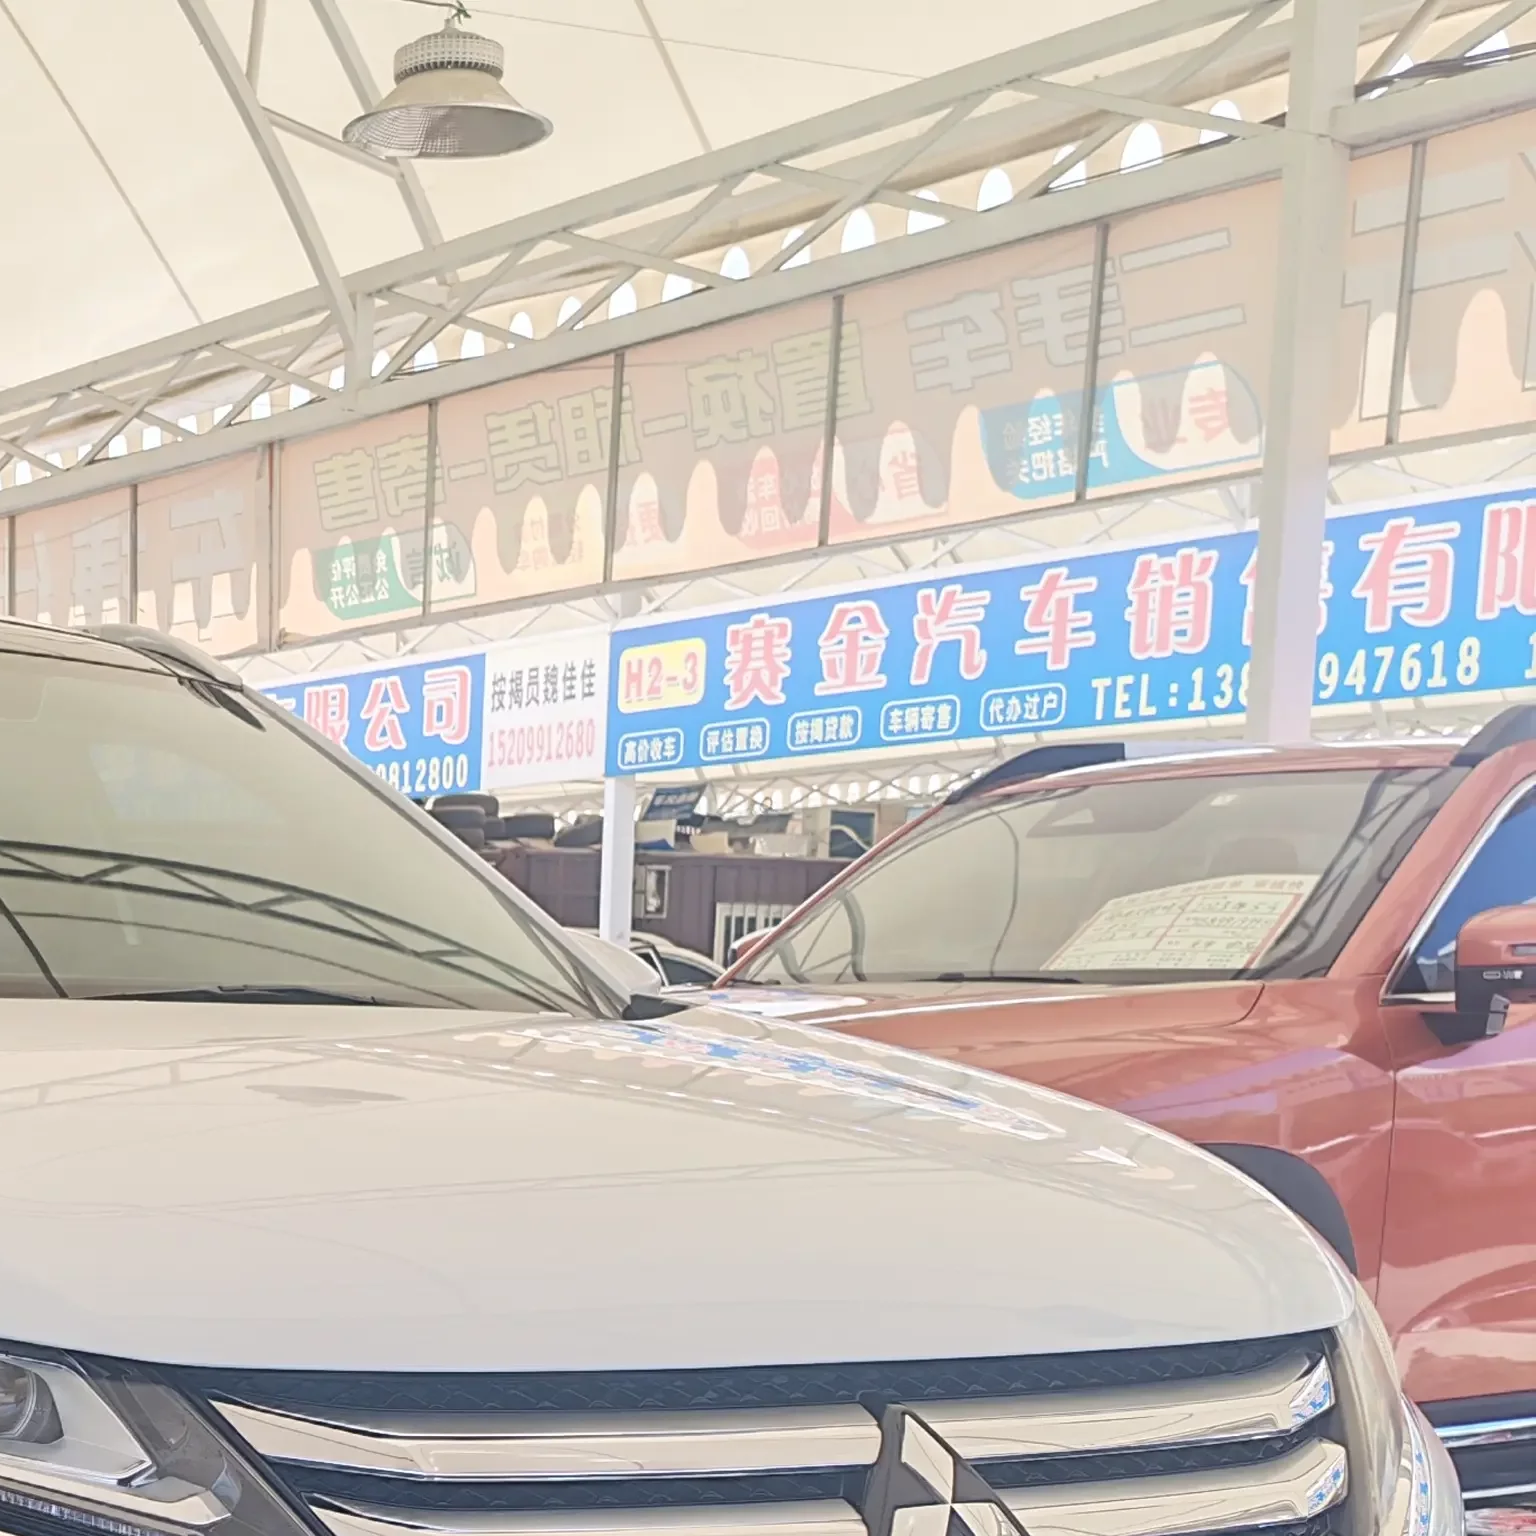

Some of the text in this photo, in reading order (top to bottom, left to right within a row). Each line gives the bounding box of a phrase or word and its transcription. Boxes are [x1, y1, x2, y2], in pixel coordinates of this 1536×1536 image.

[490, 658, 597, 713] 按揭员魏佳佳
[624, 651, 699, 702] H2-3
[270, 664, 472, 753] 限公司
[887, 701, 953, 735] 车辆寄售
[987, 690, 1060, 726] 代办过户
[488, 717, 597, 768] 15209912680
[705, 725, 764, 755] 评估置换
[793, 712, 855, 746] 按揭贷款
[622, 736, 676, 765] 高价收车
